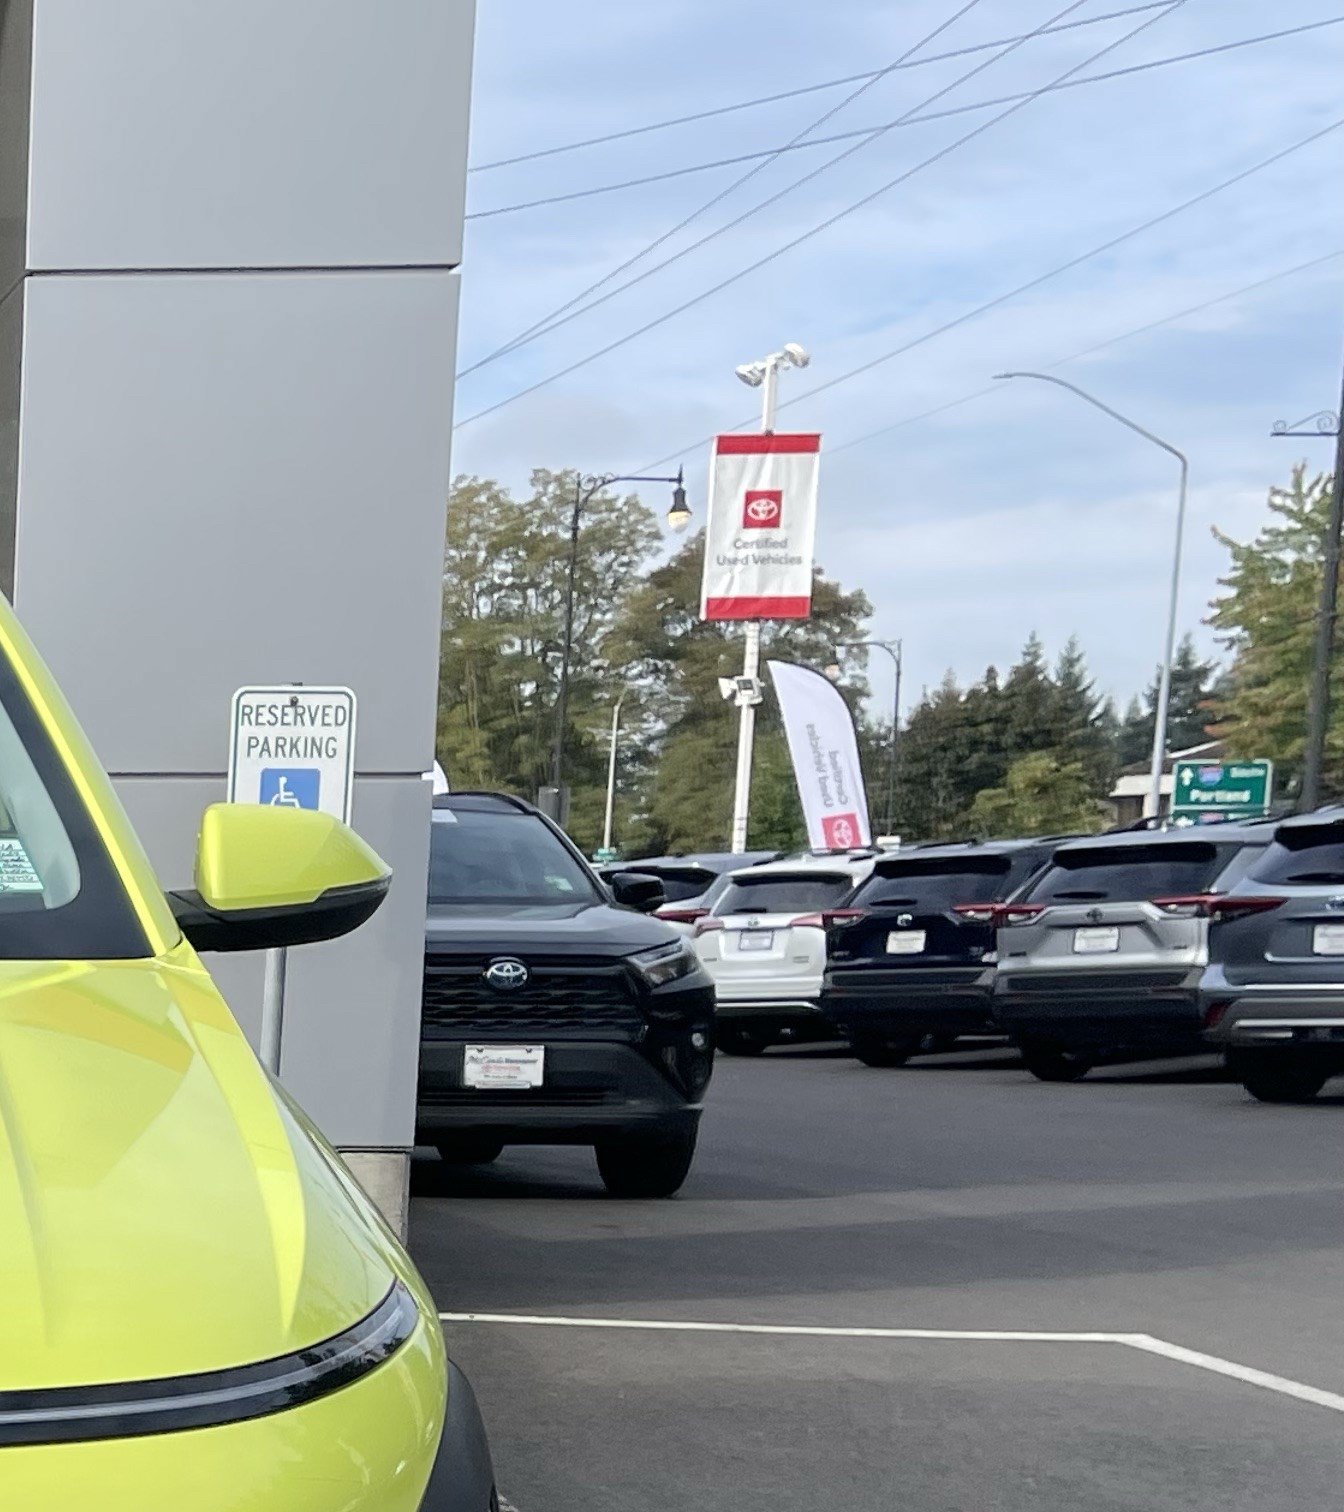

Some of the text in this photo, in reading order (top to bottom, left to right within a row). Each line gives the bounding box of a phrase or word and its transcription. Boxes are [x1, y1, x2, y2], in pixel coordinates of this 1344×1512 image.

[733, 537, 788, 549] Certified
[716, 554, 802, 566] Used Vehicles
[240, 704, 347, 727] RESERVED
[246, 736, 338, 759] PARKING
